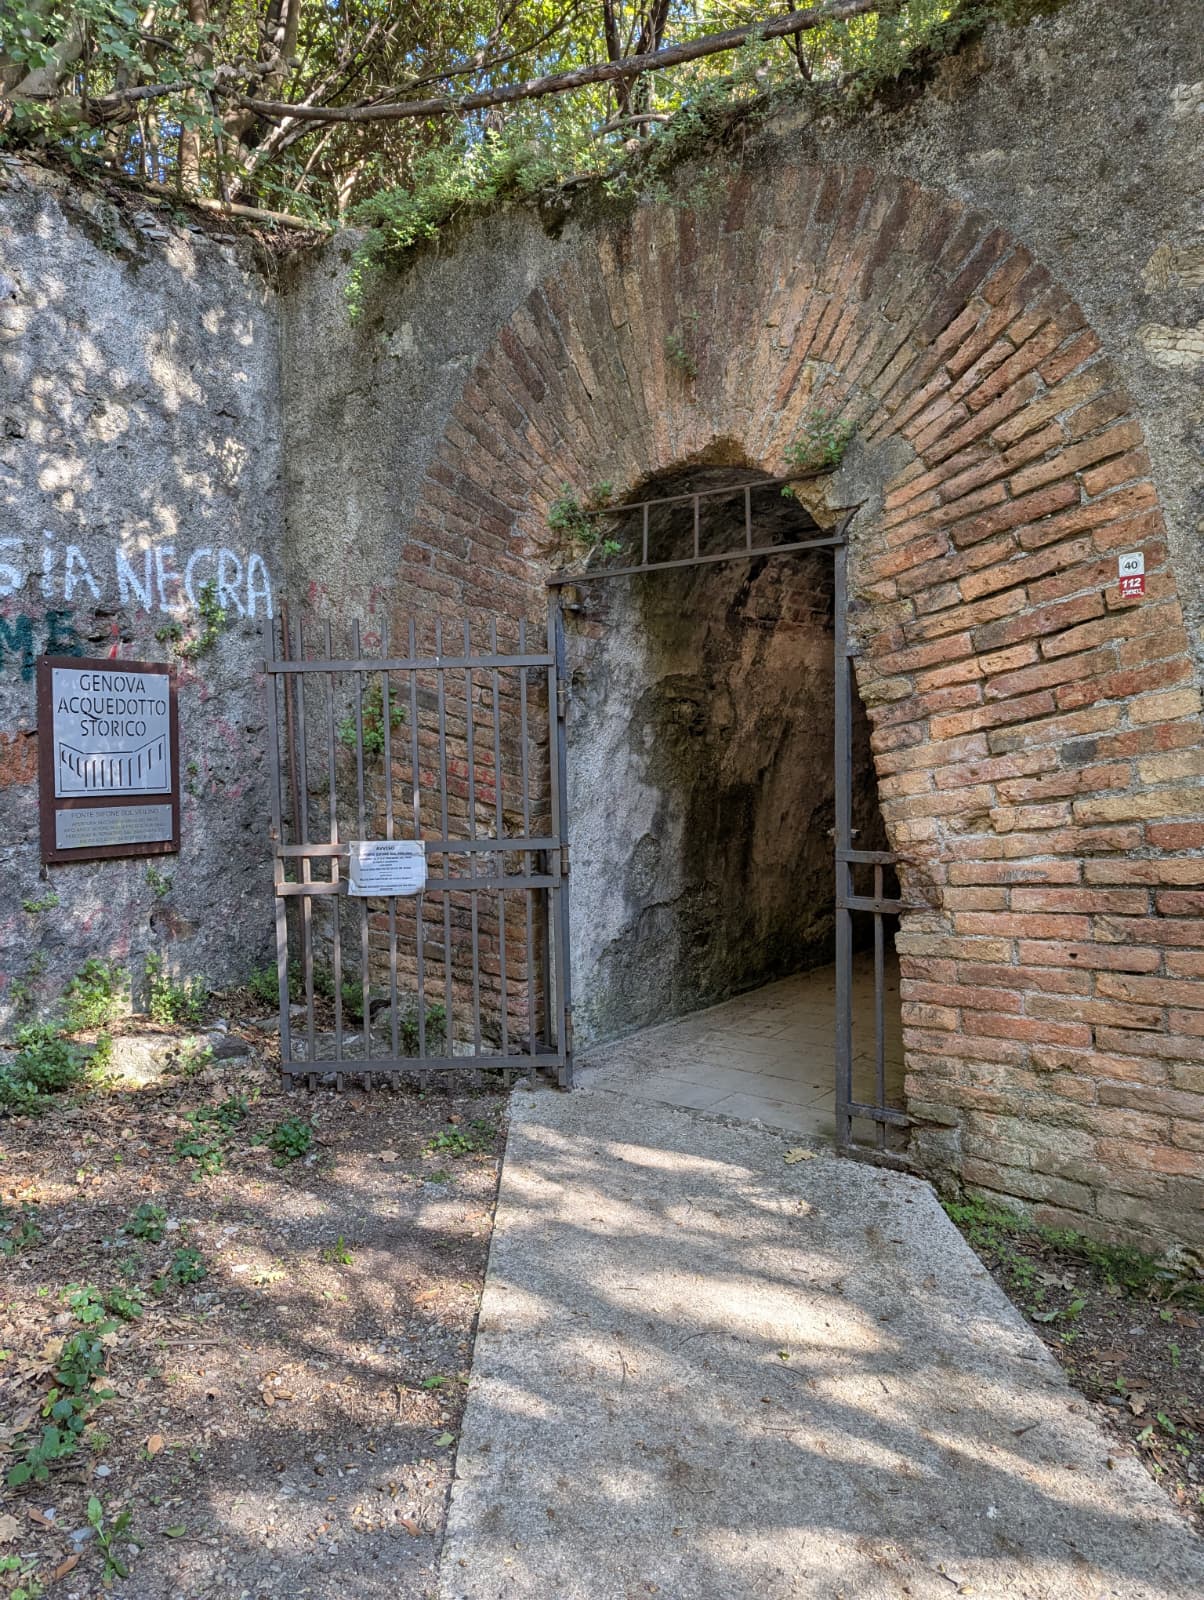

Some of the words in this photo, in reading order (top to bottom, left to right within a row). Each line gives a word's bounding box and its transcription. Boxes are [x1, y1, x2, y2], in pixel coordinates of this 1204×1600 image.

[1124, 561, 1138, 570] 40
[1122, 577, 1141, 588] 112
[79, 674, 146, 694] GENOVA
[57, 696, 167, 720] ACQUEDOTTO
[80, 719, 147, 737] STORICO
